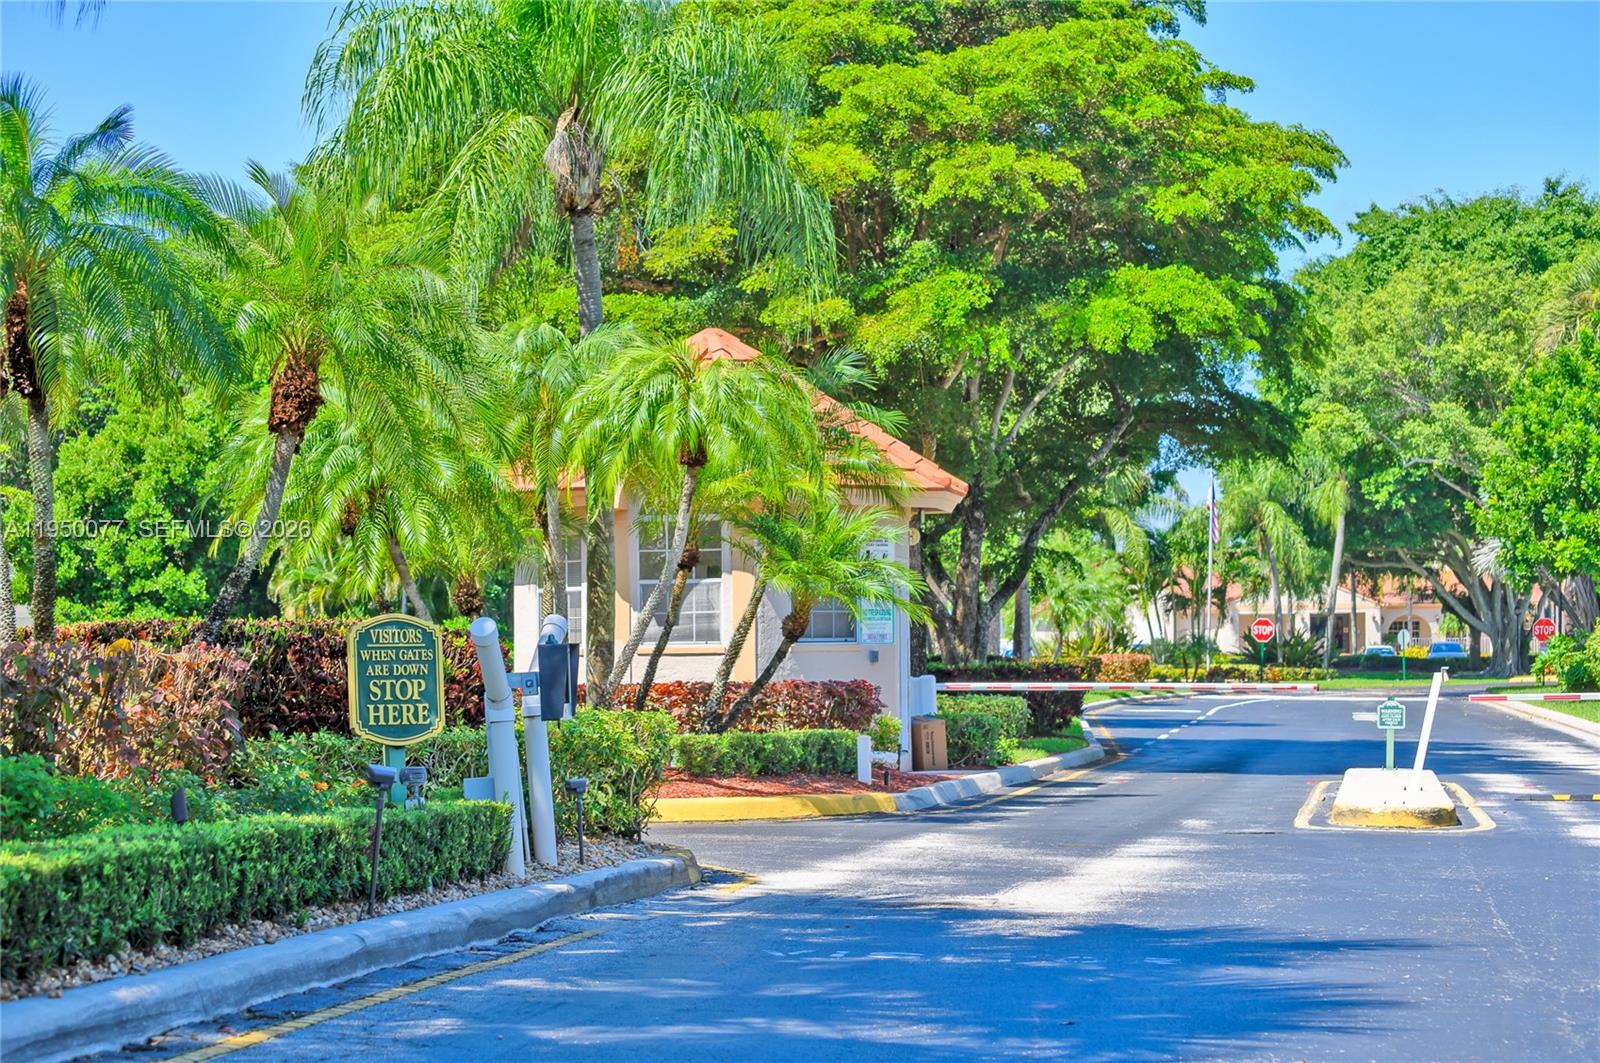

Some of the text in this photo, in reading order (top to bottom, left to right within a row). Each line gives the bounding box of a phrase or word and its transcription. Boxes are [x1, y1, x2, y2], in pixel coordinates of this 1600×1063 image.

[370, 628, 423, 643] VISITORS
[1253, 625, 1273, 636] STOP
[1534, 625, 1555, 636] STOP
[360, 649, 434, 661] WHEN GATES
[366, 664, 428, 676] ARE DOWN
[368, 679, 426, 701] STOP
[367, 703, 431, 726] HERE
